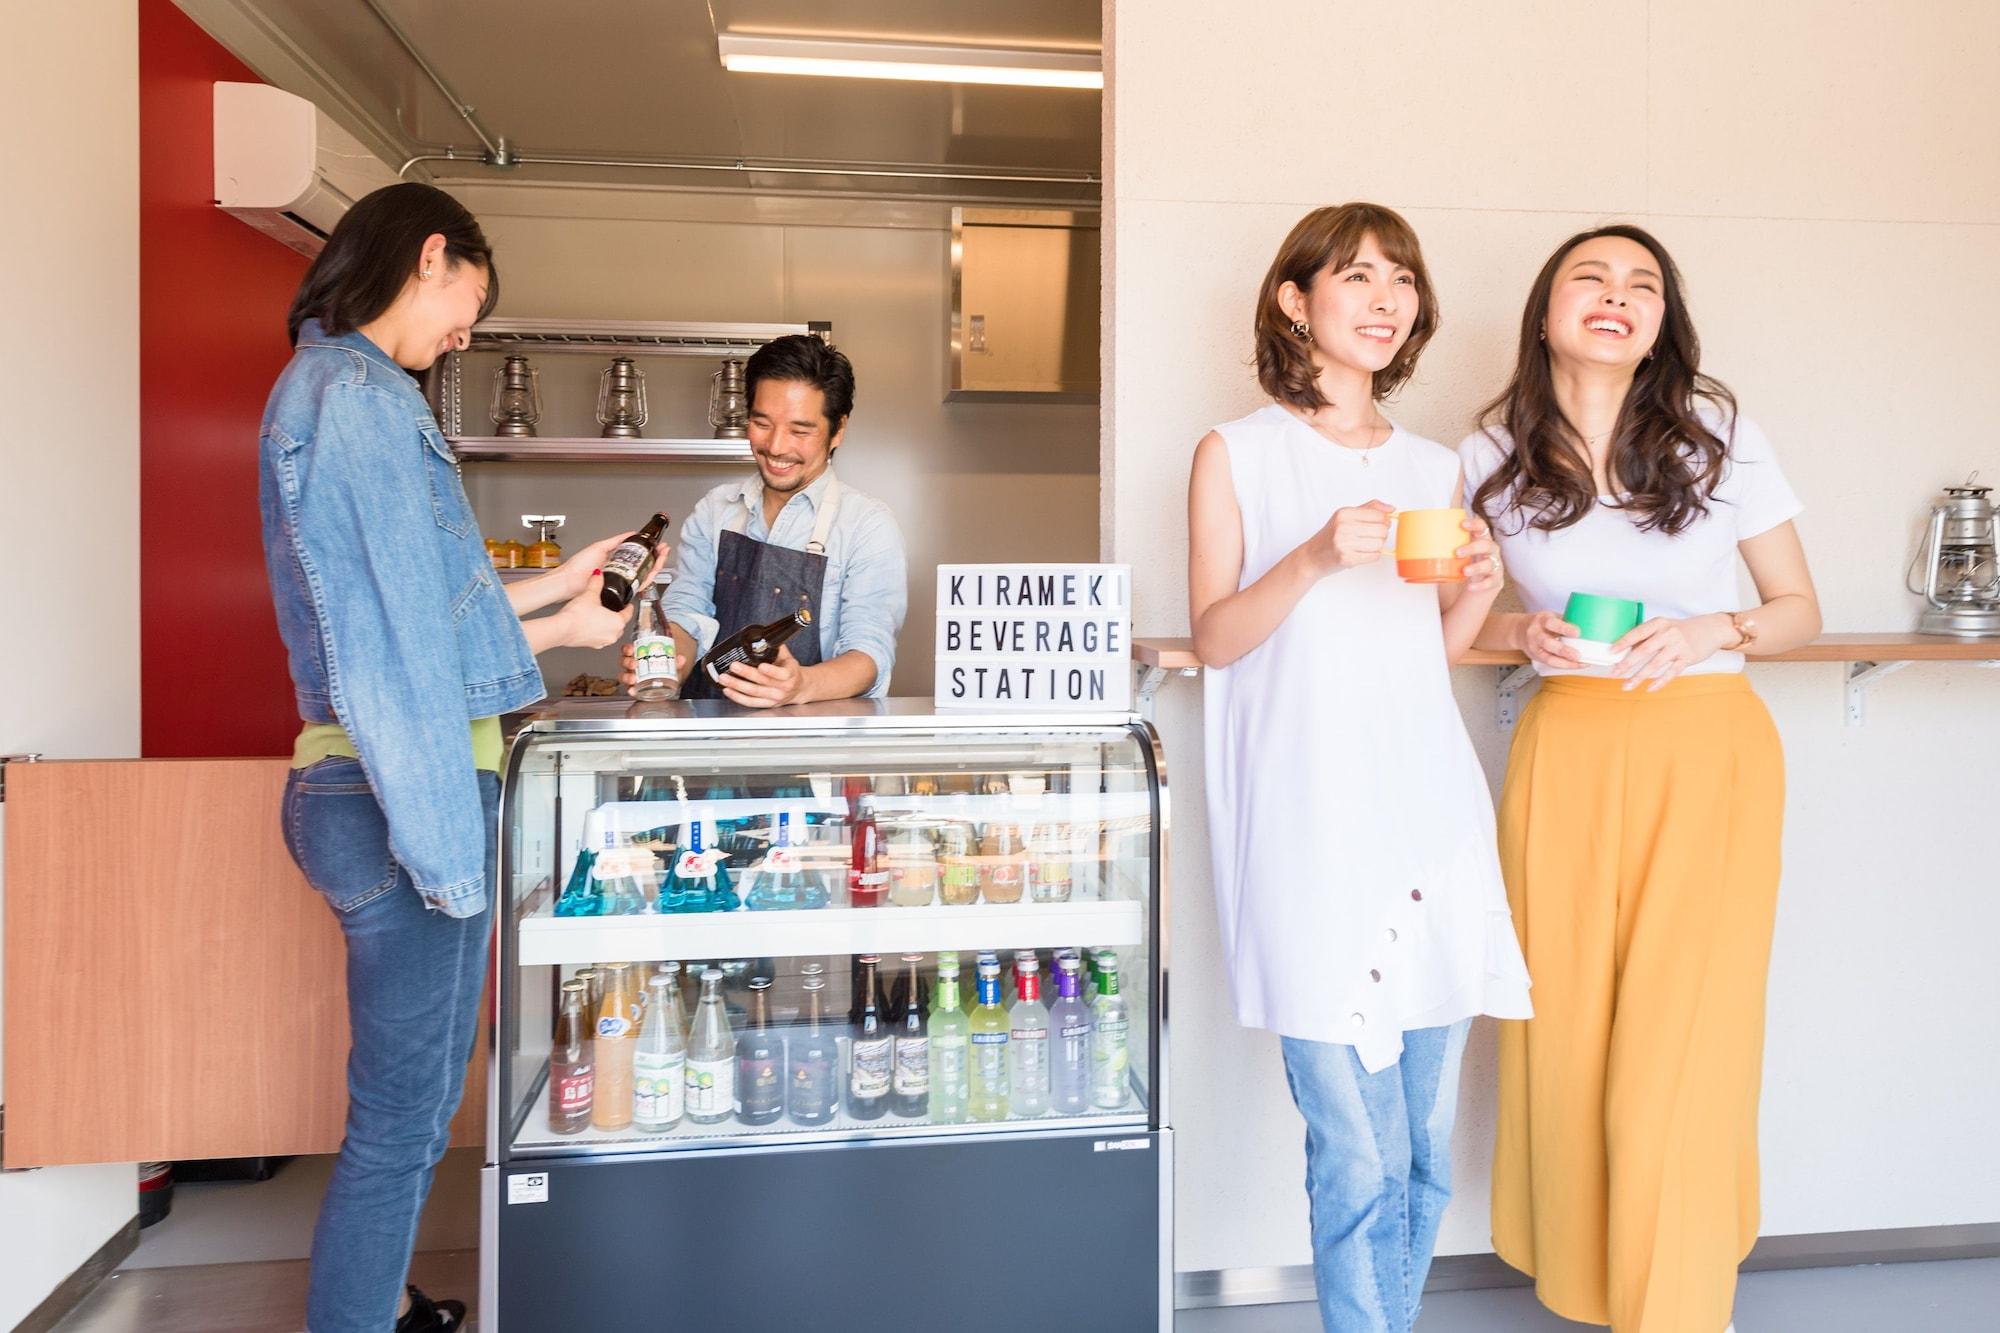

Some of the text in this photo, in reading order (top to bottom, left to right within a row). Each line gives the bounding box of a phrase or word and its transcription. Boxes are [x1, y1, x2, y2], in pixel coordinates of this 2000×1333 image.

[951, 575, 1121, 605] KIRAMEKI
[947, 621, 1119, 652] BEVERAGE
[952, 667, 1104, 700] STATION
